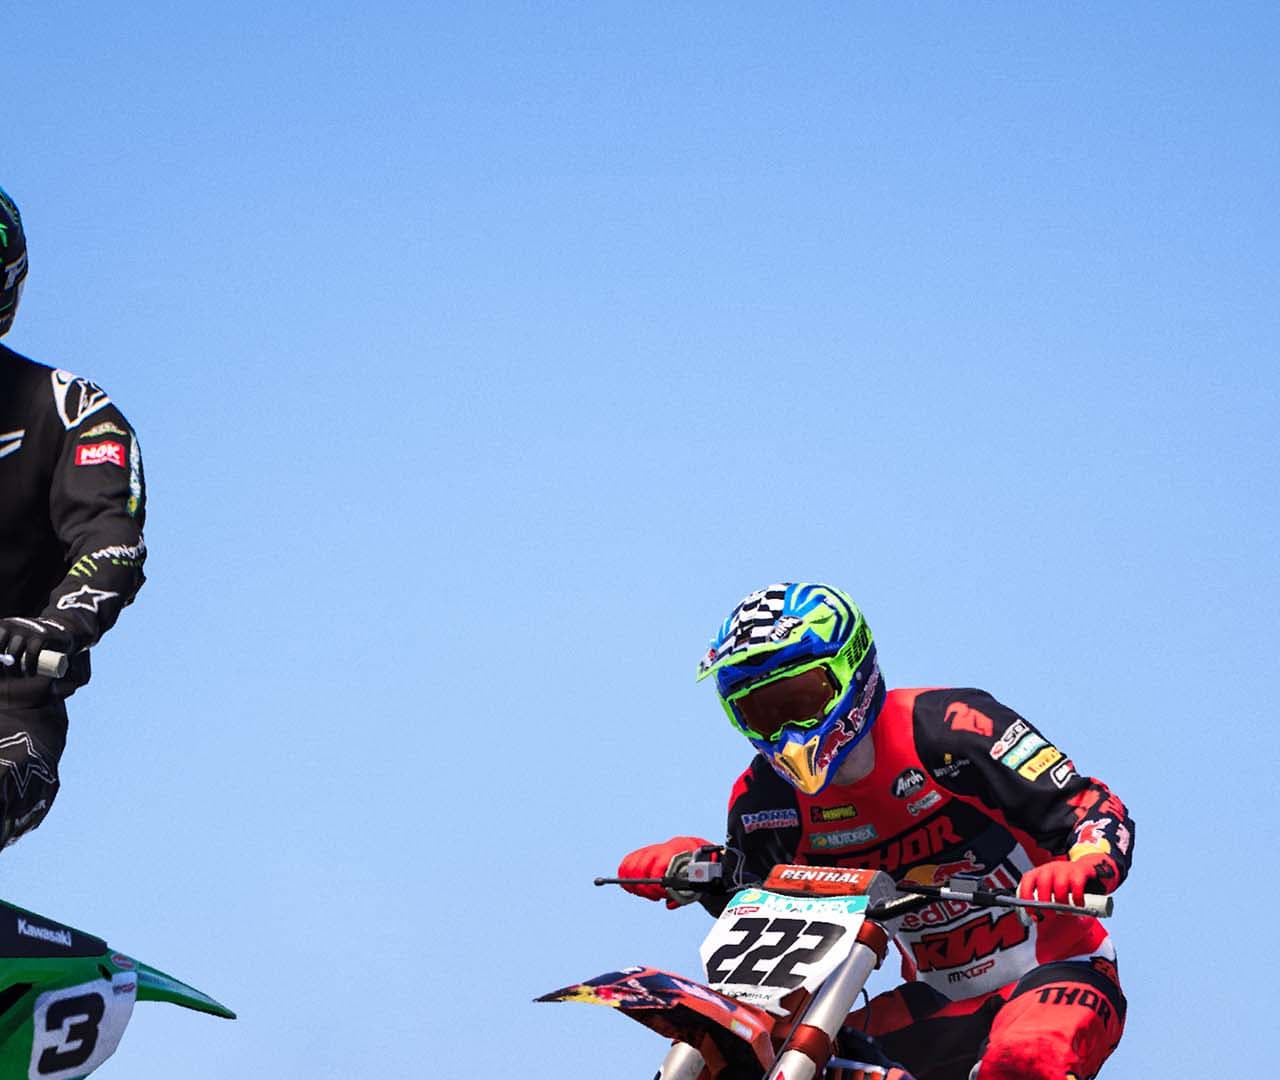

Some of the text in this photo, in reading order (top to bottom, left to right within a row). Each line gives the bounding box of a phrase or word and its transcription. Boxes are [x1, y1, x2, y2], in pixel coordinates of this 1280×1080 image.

[826, 828, 873, 847] MOTOREX
[780, 869, 861, 884] RENTHAL
[17, 919, 72, 947] Kawasaki
[912, 909, 1029, 973] KTM
[705, 917, 848, 990] 222
[947, 959, 995, 984] MXGP
[1035, 986, 1112, 1029] THOR
[37, 991, 106, 1075] 3
